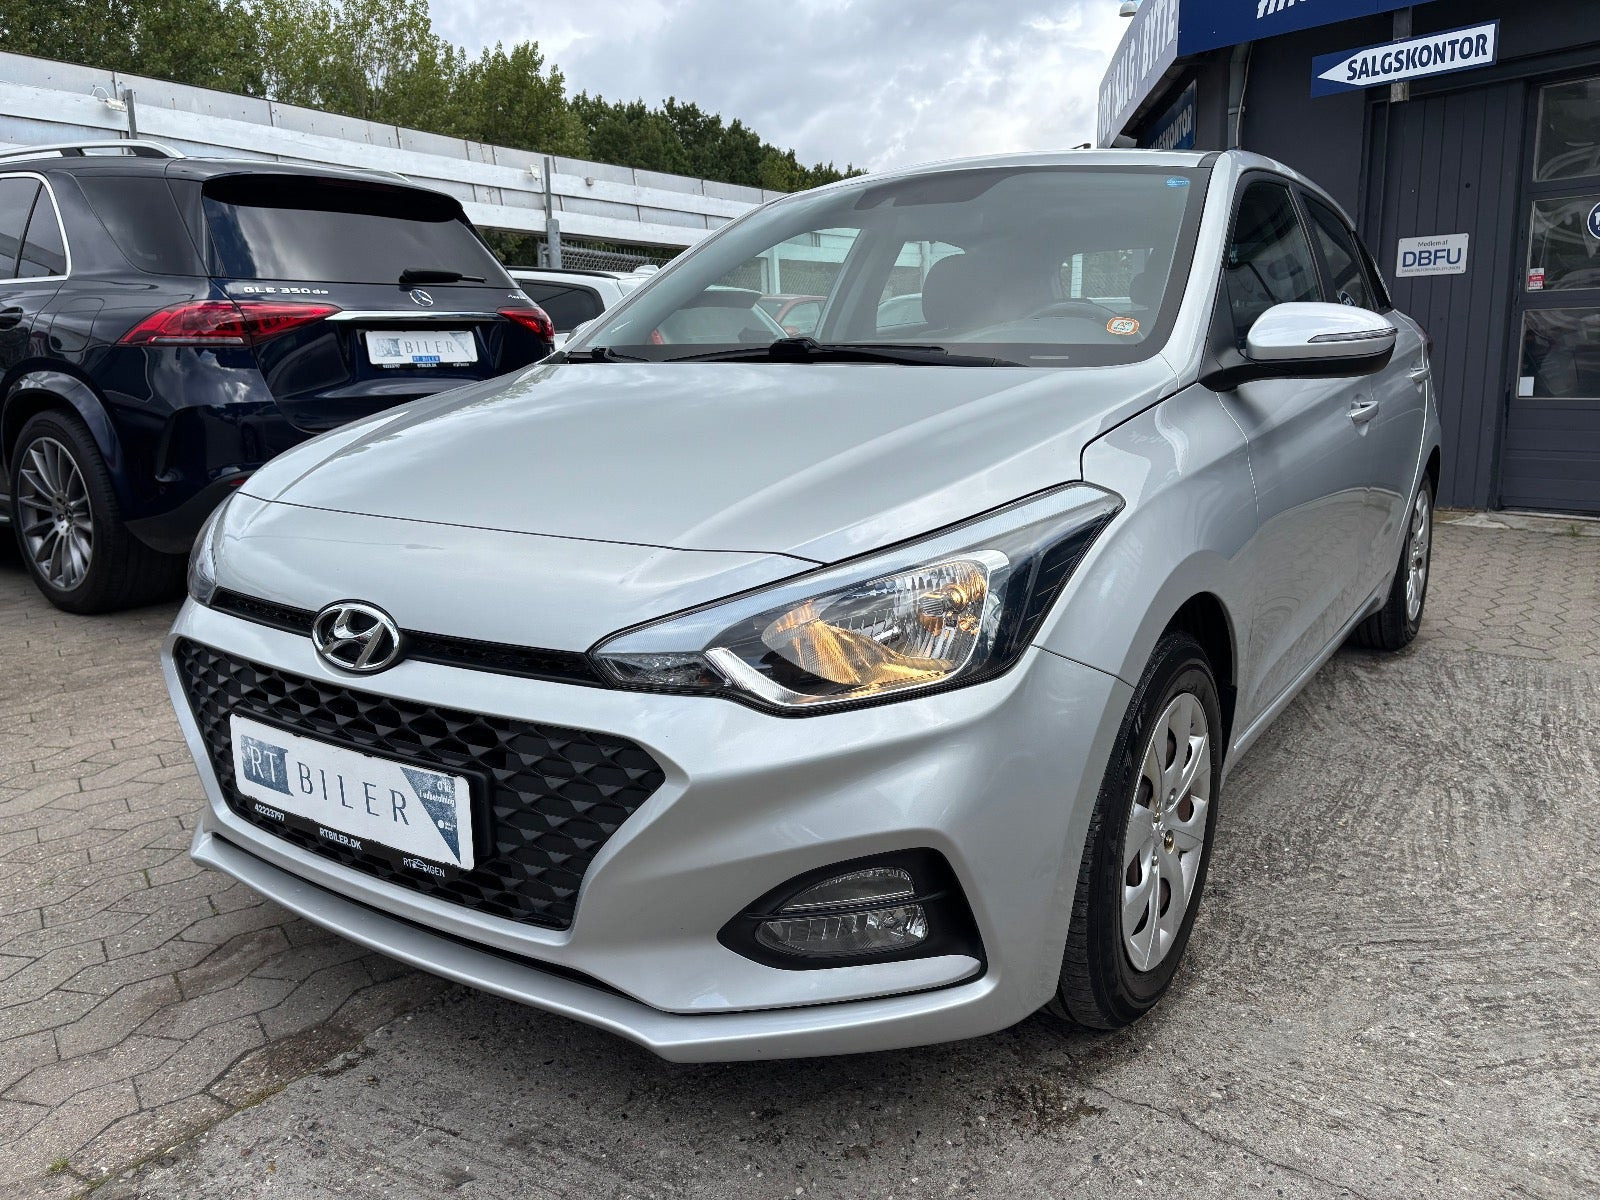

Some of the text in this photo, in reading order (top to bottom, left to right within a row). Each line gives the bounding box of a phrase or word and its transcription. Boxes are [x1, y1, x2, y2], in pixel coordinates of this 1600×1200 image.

[1115, 38, 1135, 119] SALG
[1141, 0, 1175, 80] BYTTE
[1346, 33, 1488, 81] SALGSKONTOR
[1150, 104, 1193, 149] GSKONTOR
[1417, 240, 1442, 248] Medlem
[1402, 247, 1462, 268] DBFU
[404, 339, 456, 354] BILER
[249, 744, 410, 826] RT BILER
[254, 803, 285, 822] 42223797
[319, 827, 364, 851] RTBILER.DK
